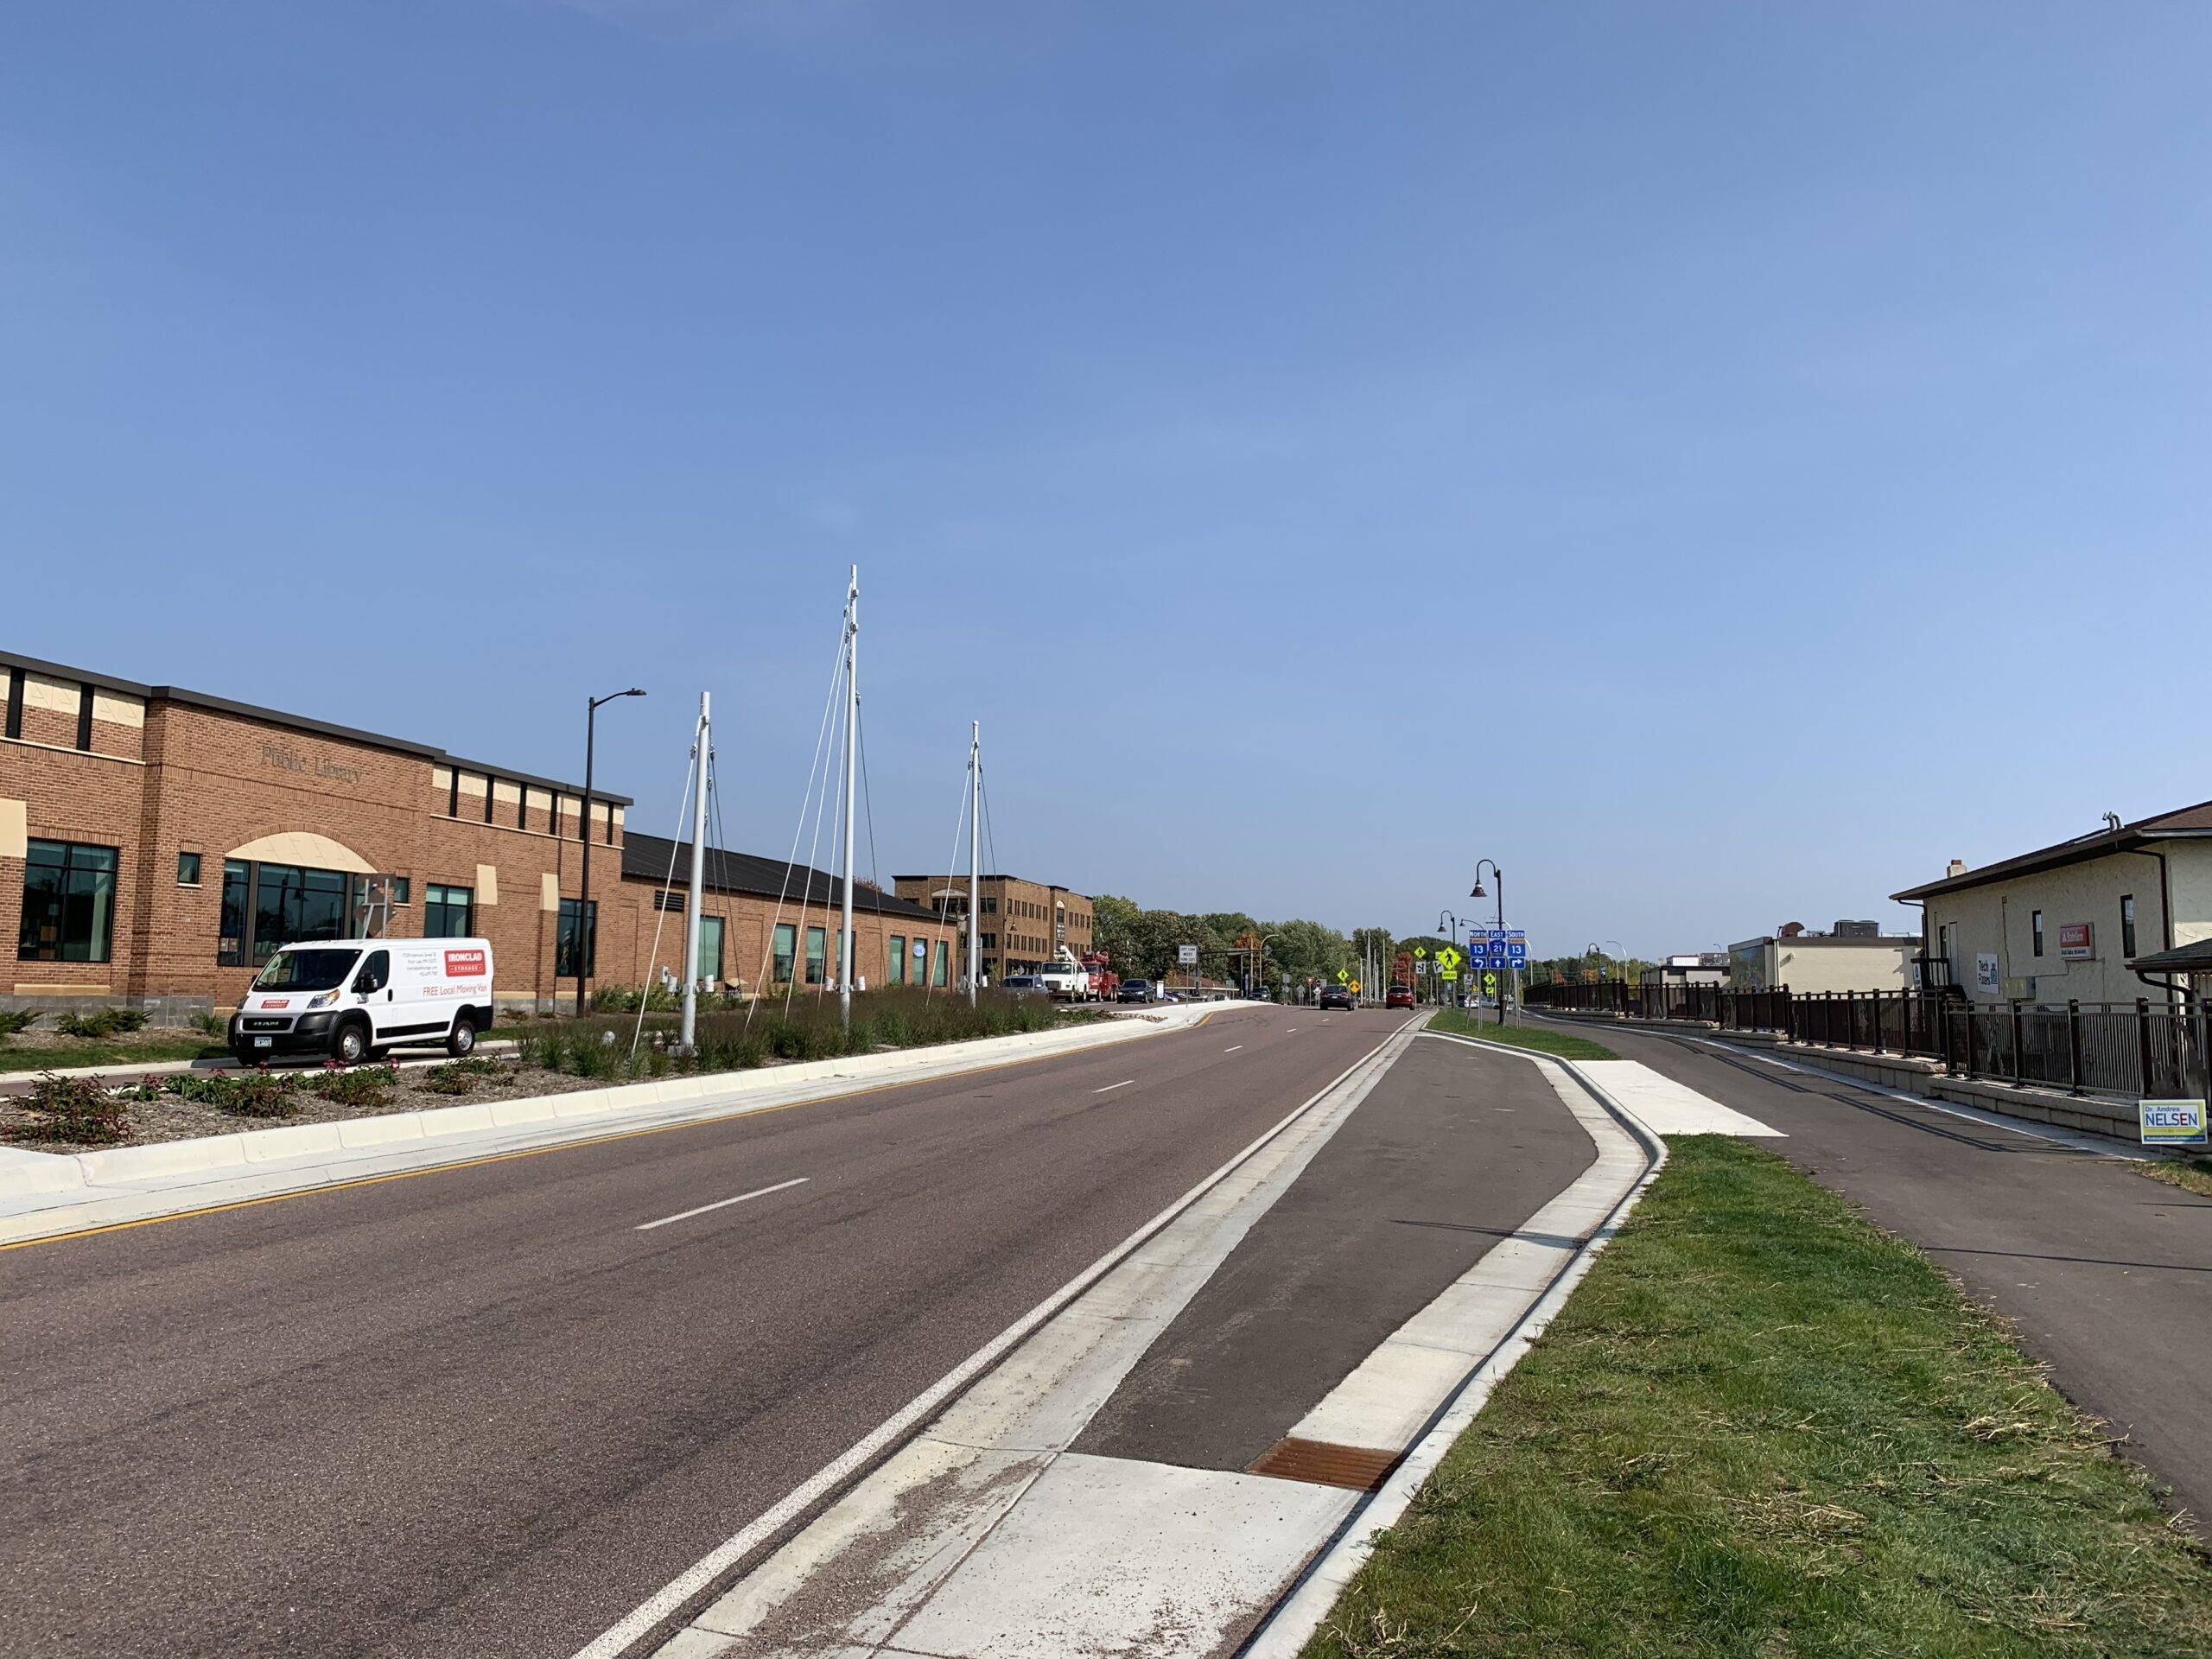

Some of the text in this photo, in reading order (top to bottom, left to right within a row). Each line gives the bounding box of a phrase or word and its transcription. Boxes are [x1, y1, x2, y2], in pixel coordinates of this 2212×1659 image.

[261, 745, 364, 784] Public Library
[1473, 945, 1484, 954] 13
[1511, 945, 1522, 954] 13
[448, 952, 483, 963] IRONCLAD
[423, 982, 487, 997] FREE Local Moving Van
[2145, 1113, 2197, 1126] NELSEN
